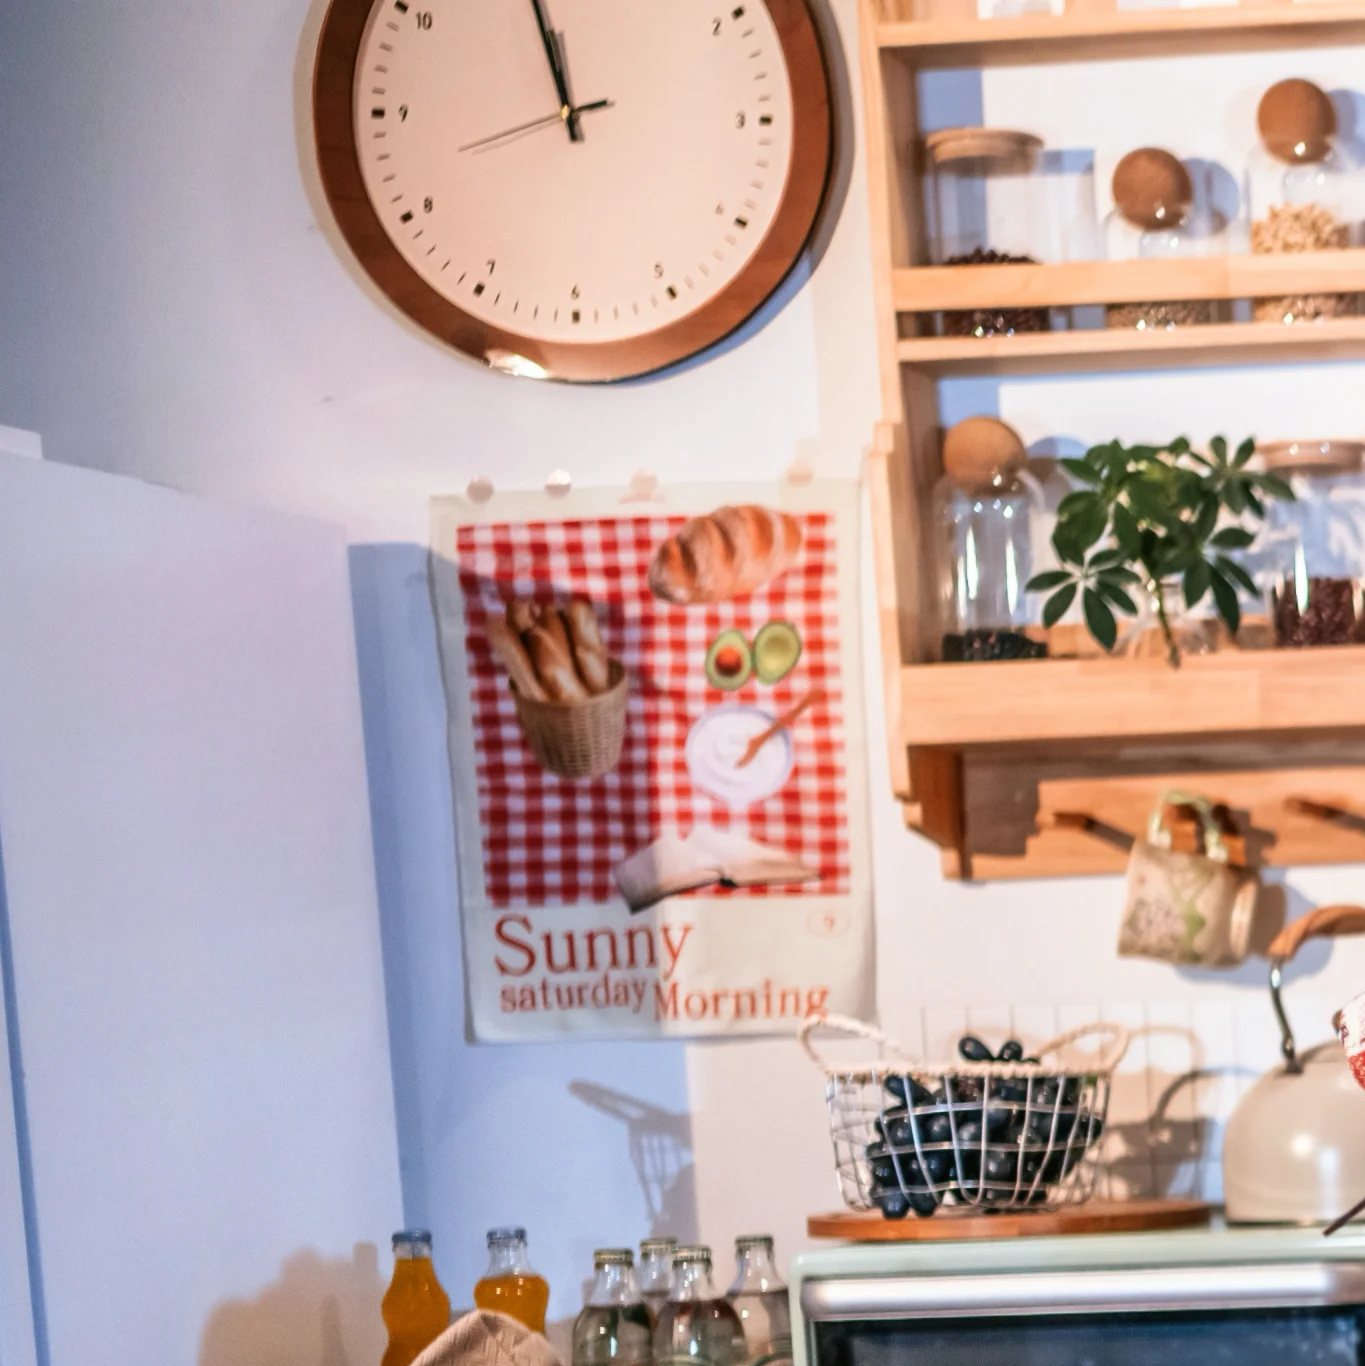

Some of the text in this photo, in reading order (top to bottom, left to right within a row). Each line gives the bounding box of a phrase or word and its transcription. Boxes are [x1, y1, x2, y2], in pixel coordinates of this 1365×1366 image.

[415, 11, 433, 31] 10
[711, 16, 722, 37] 2
[486, 259, 497, 277] 7
[570, 282, 580, 300] 6
[494, 913, 693, 981] Sunny
[500, 969, 830, 1021] saturday Morning
